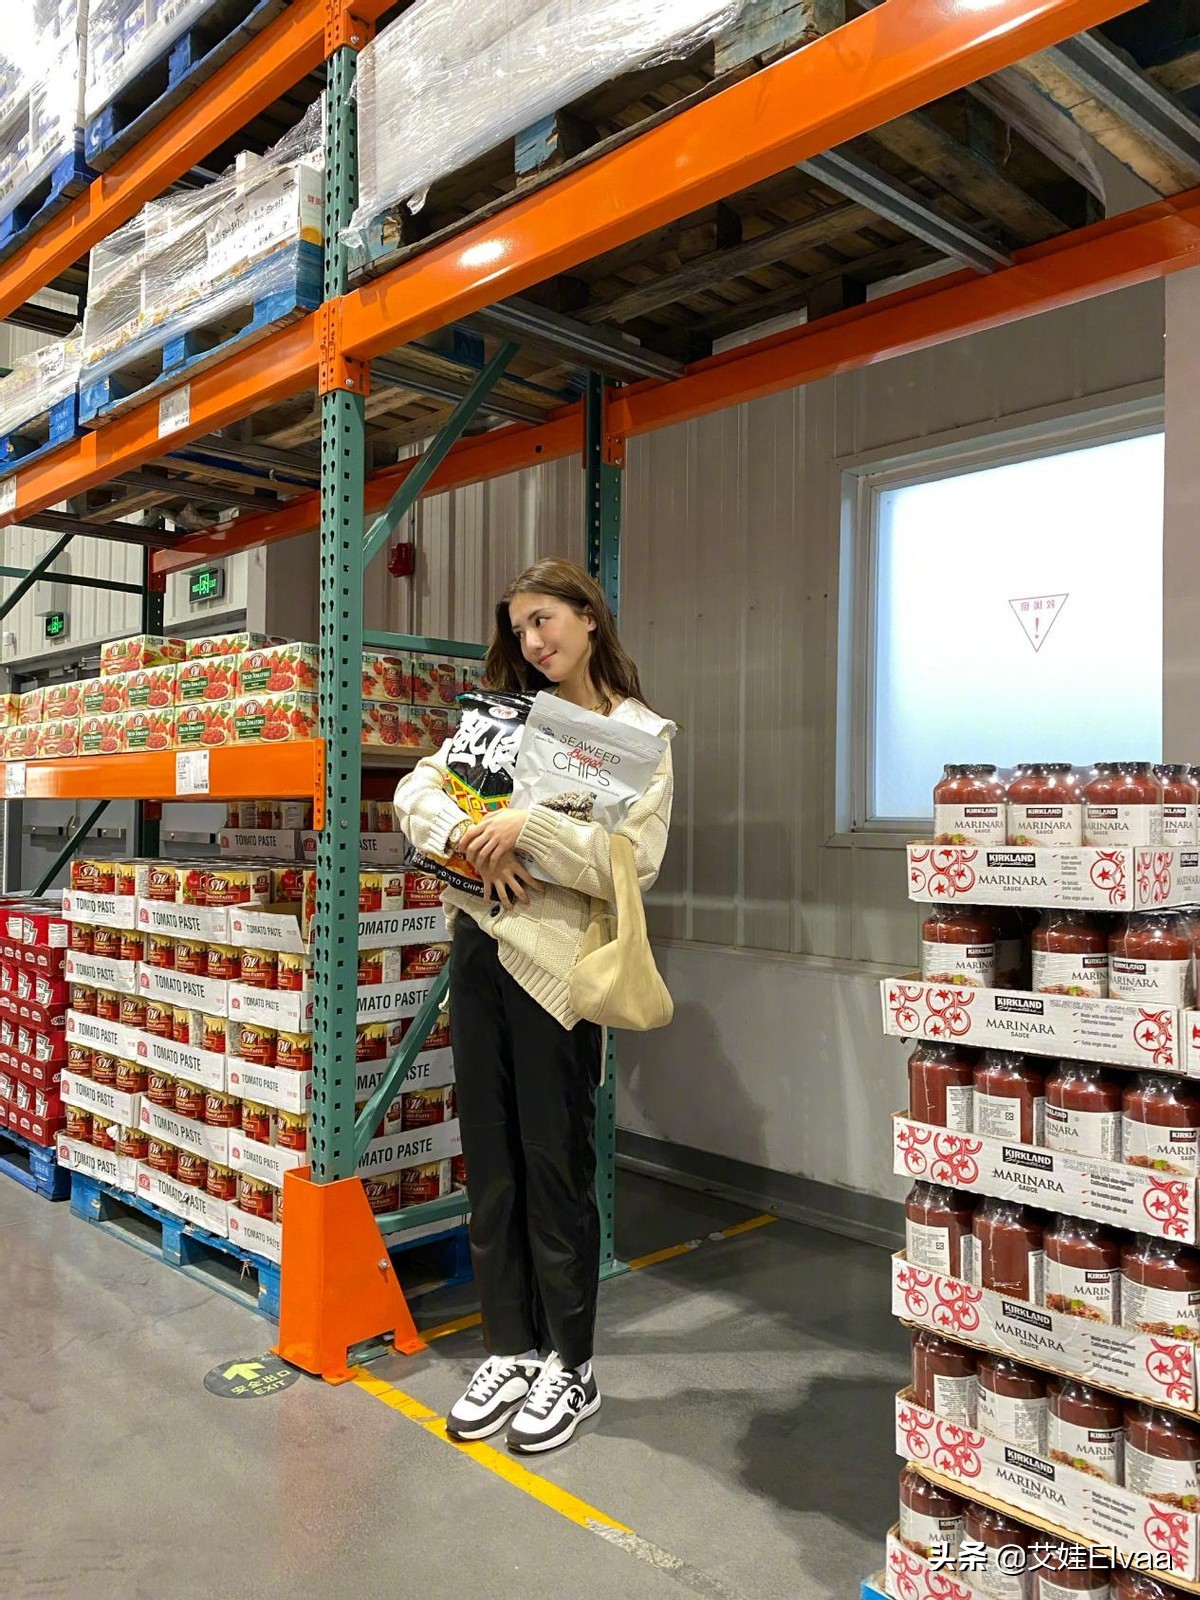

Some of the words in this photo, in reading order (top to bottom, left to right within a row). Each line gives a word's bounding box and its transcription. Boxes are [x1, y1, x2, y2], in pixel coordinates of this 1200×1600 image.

[560, 734, 620, 765] SEAWEED
[553, 752, 611, 786] CHIPS
[1018, 821, 1072, 830] MARINARA
[235, 835, 256, 846] TOMATO
[258, 835, 277, 847] PASTE
[360, 839, 377, 850] ASTE
[989, 854, 1034, 862] KIRKLAND
[463, 882, 484, 893] CHIPS
[978, 875, 1048, 886] MARINARA
[76, 898, 96, 912] TOMATO
[97, 901, 115, 914] PASTE
[152, 912, 177, 928] TOMATO
[178, 916, 201, 931] PASTE
[358, 919, 398, 936] OMATO
[402, 916, 436, 931] PASTE
[76, 963, 96, 978] TOMATO
[97, 968, 115, 981] PASTE
[155, 975, 181, 992] TOMATO
[184, 980, 205, 998] PASTE
[243, 997, 264, 1007] TOMATO
[266, 1000, 279, 1010] PASTE
[357, 995, 391, 1012] MATO
[997, 997, 1042, 1009] KIRKLAND
[78, 1023, 100, 1039] TOMATO
[101, 1029, 118, 1045] PASTE
[986, 1018, 1056, 1035] MARINARA
[1010, 1031, 1030, 1039] SAUCE
[153, 1044, 177, 1063] TOMATO
[180, 1053, 201, 1071] PASTE
[242, 1074, 262, 1086] TOMATO
[264, 1080, 279, 1091] PASTE
[357, 1072, 383, 1090] MAT
[75, 1082, 95, 1100] TOMATO
[97, 1090, 114, 1108] PASTE
[153, 1114, 179, 1136] TOMATO
[181, 1126, 202, 1146] PASTE
[358, 1147, 393, 1168] MATO
[397, 1138, 432, 1158] PASTE
[1005, 1149, 1051, 1165] KIRKLAND
[1157, 1145, 1196, 1155] MARIN
[74, 1151, 95, 1170] TOMATO
[97, 1159, 117, 1176] PASTE
[243, 1150, 262, 1166] TOMATO
[264, 1159, 279, 1171] PASTE
[992, 1168, 1064, 1192] MARINARA
[1019, 1185, 1038, 1193] SAUCE
[243, 1228, 265, 1243] TOMATO
[266, 1236, 280, 1251] PASTE
[1074, 1285, 1110, 1296] MARIN
[1004, 1304, 1051, 1324] KIRKLAND
[995, 1320, 1065, 1353] MARINARA
[1020, 1339, 1040, 1350] SAUCE
[231, 1370, 291, 1395] 安全出口
[254, 1380, 285, 1395] EXIT
[1076, 1444, 1115, 1456] MARIN
[1007, 1450, 1054, 1475] KIRKLAND
[996, 1468, 1067, 1506] MARINARA
[1021, 1487, 1042, 1500] SAUCE
